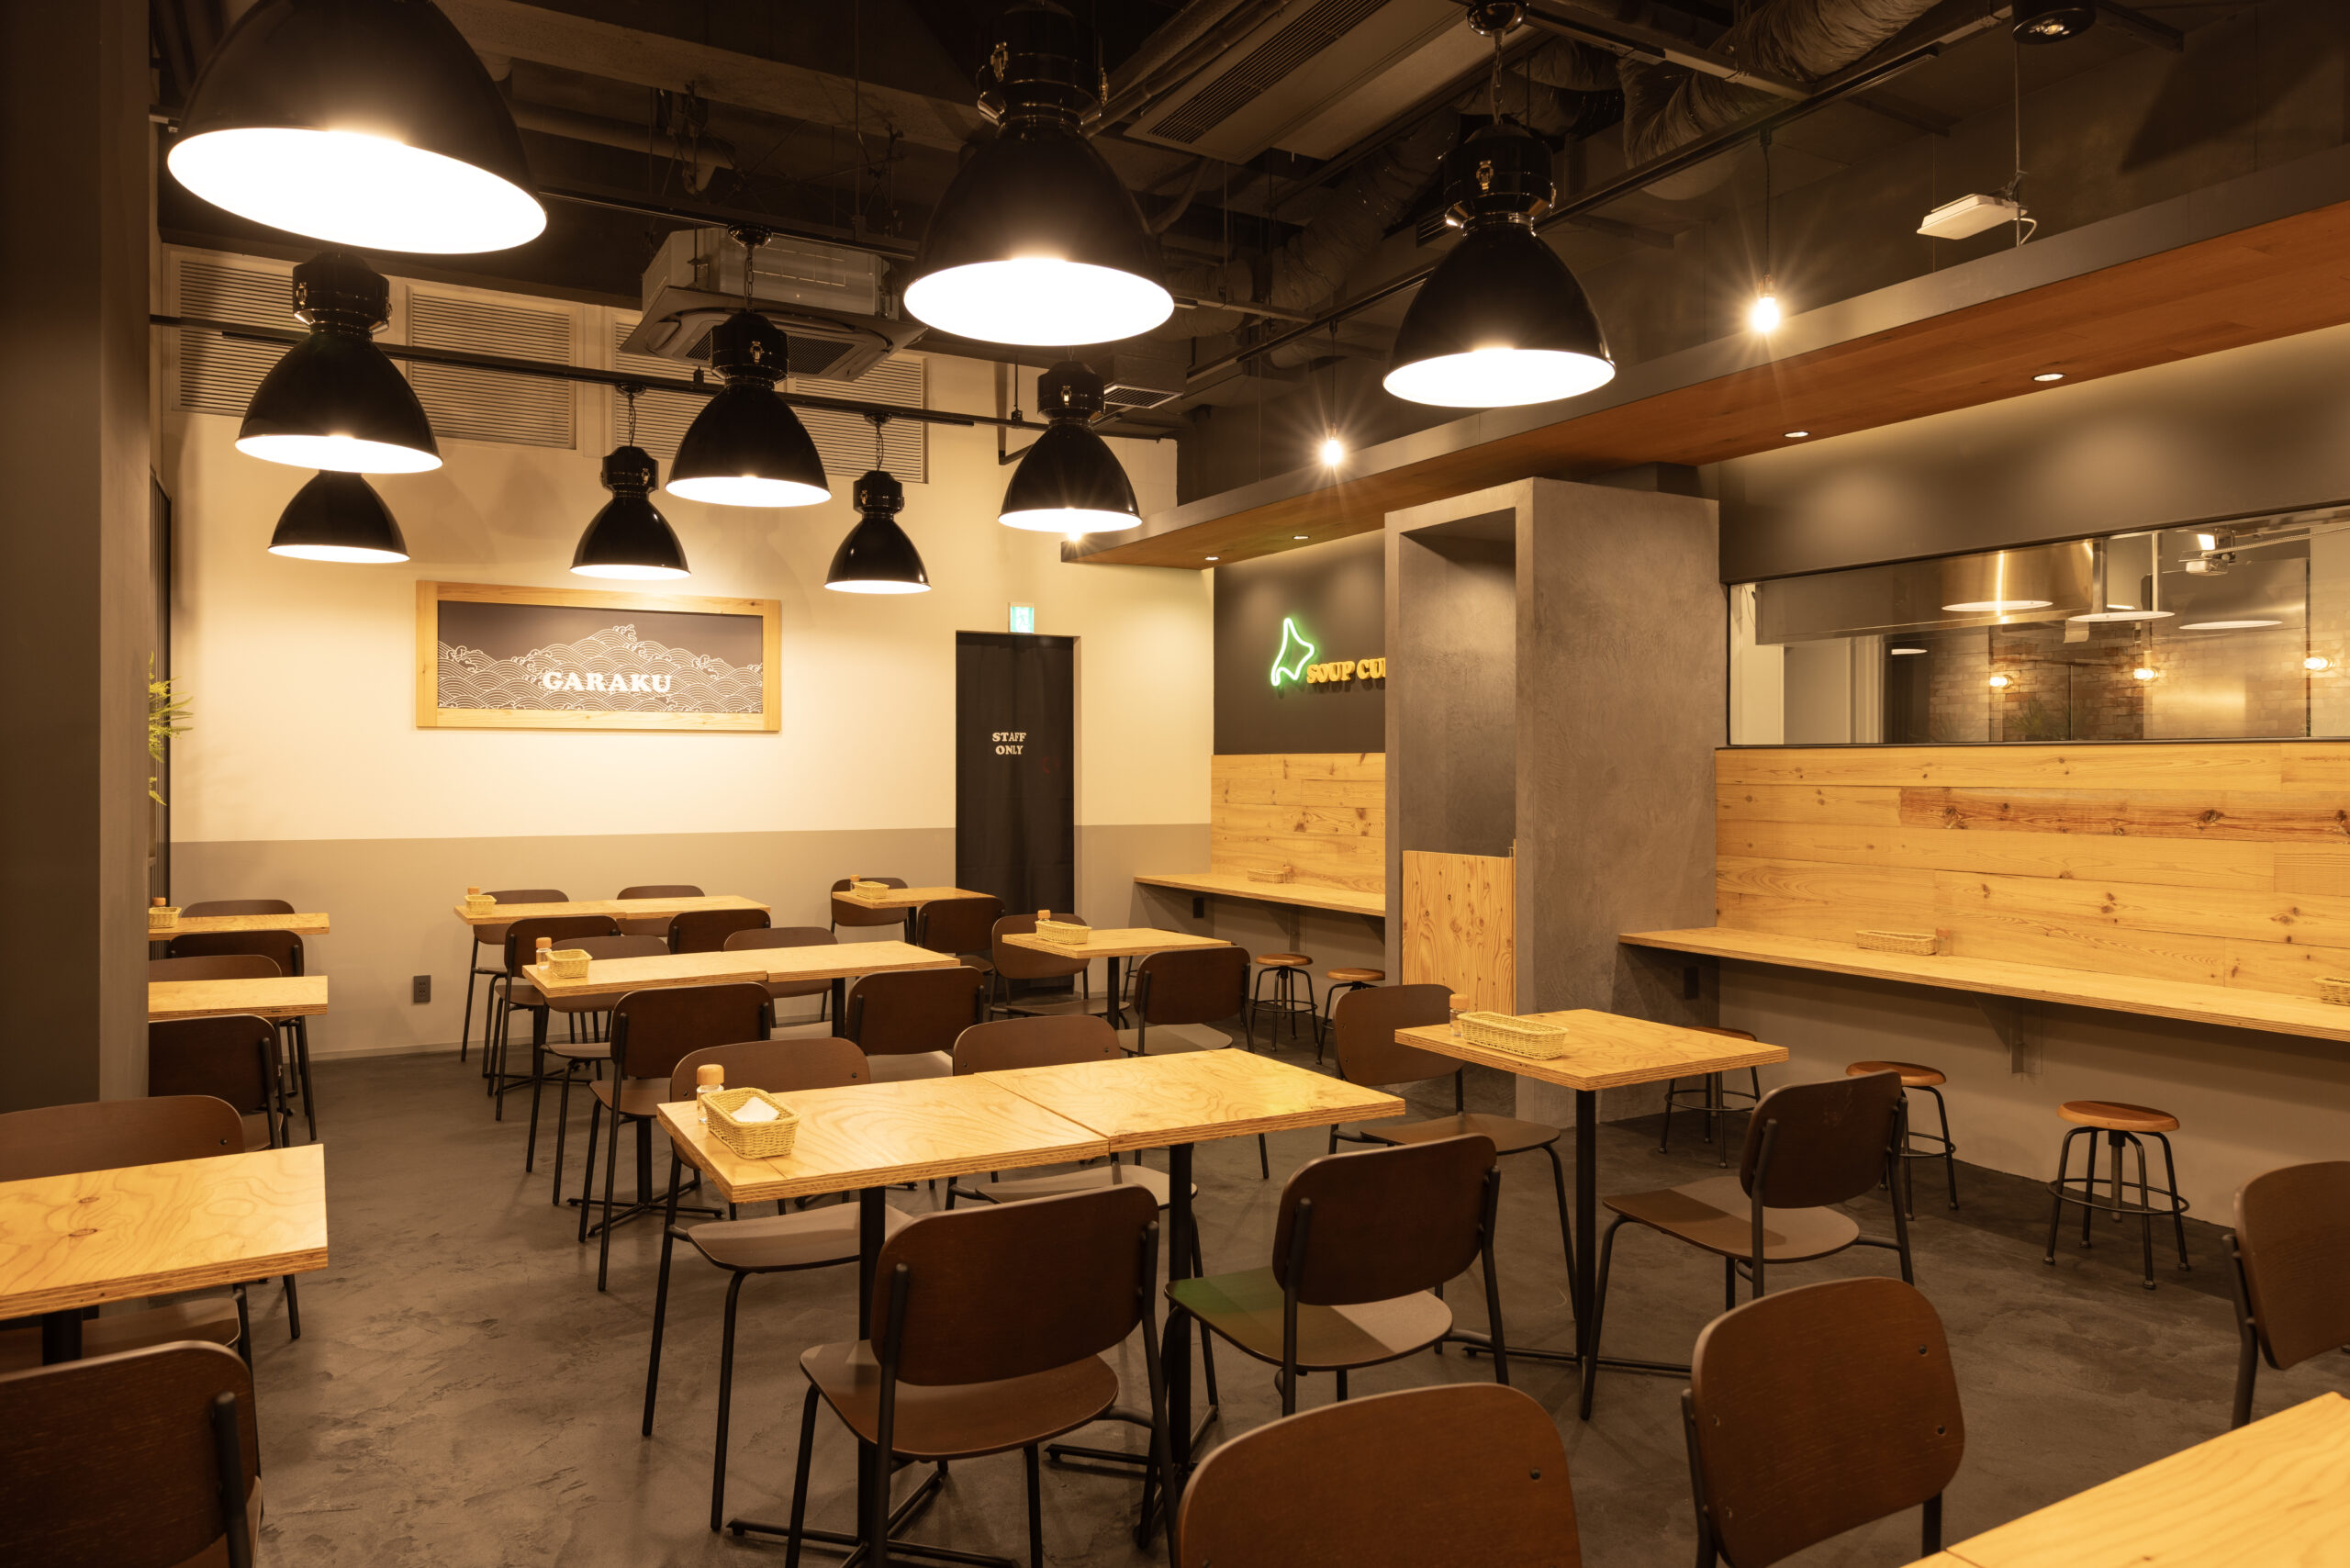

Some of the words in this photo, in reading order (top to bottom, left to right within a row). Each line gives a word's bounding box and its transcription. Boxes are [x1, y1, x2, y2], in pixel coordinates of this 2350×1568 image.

[1306, 660, 1355, 684] SOUP
[1356, 657, 1385, 679] CU
[543, 672, 672, 692] GARAKU
[991, 732, 1026, 743] STAFF
[995, 745, 1024, 756] ONLY
